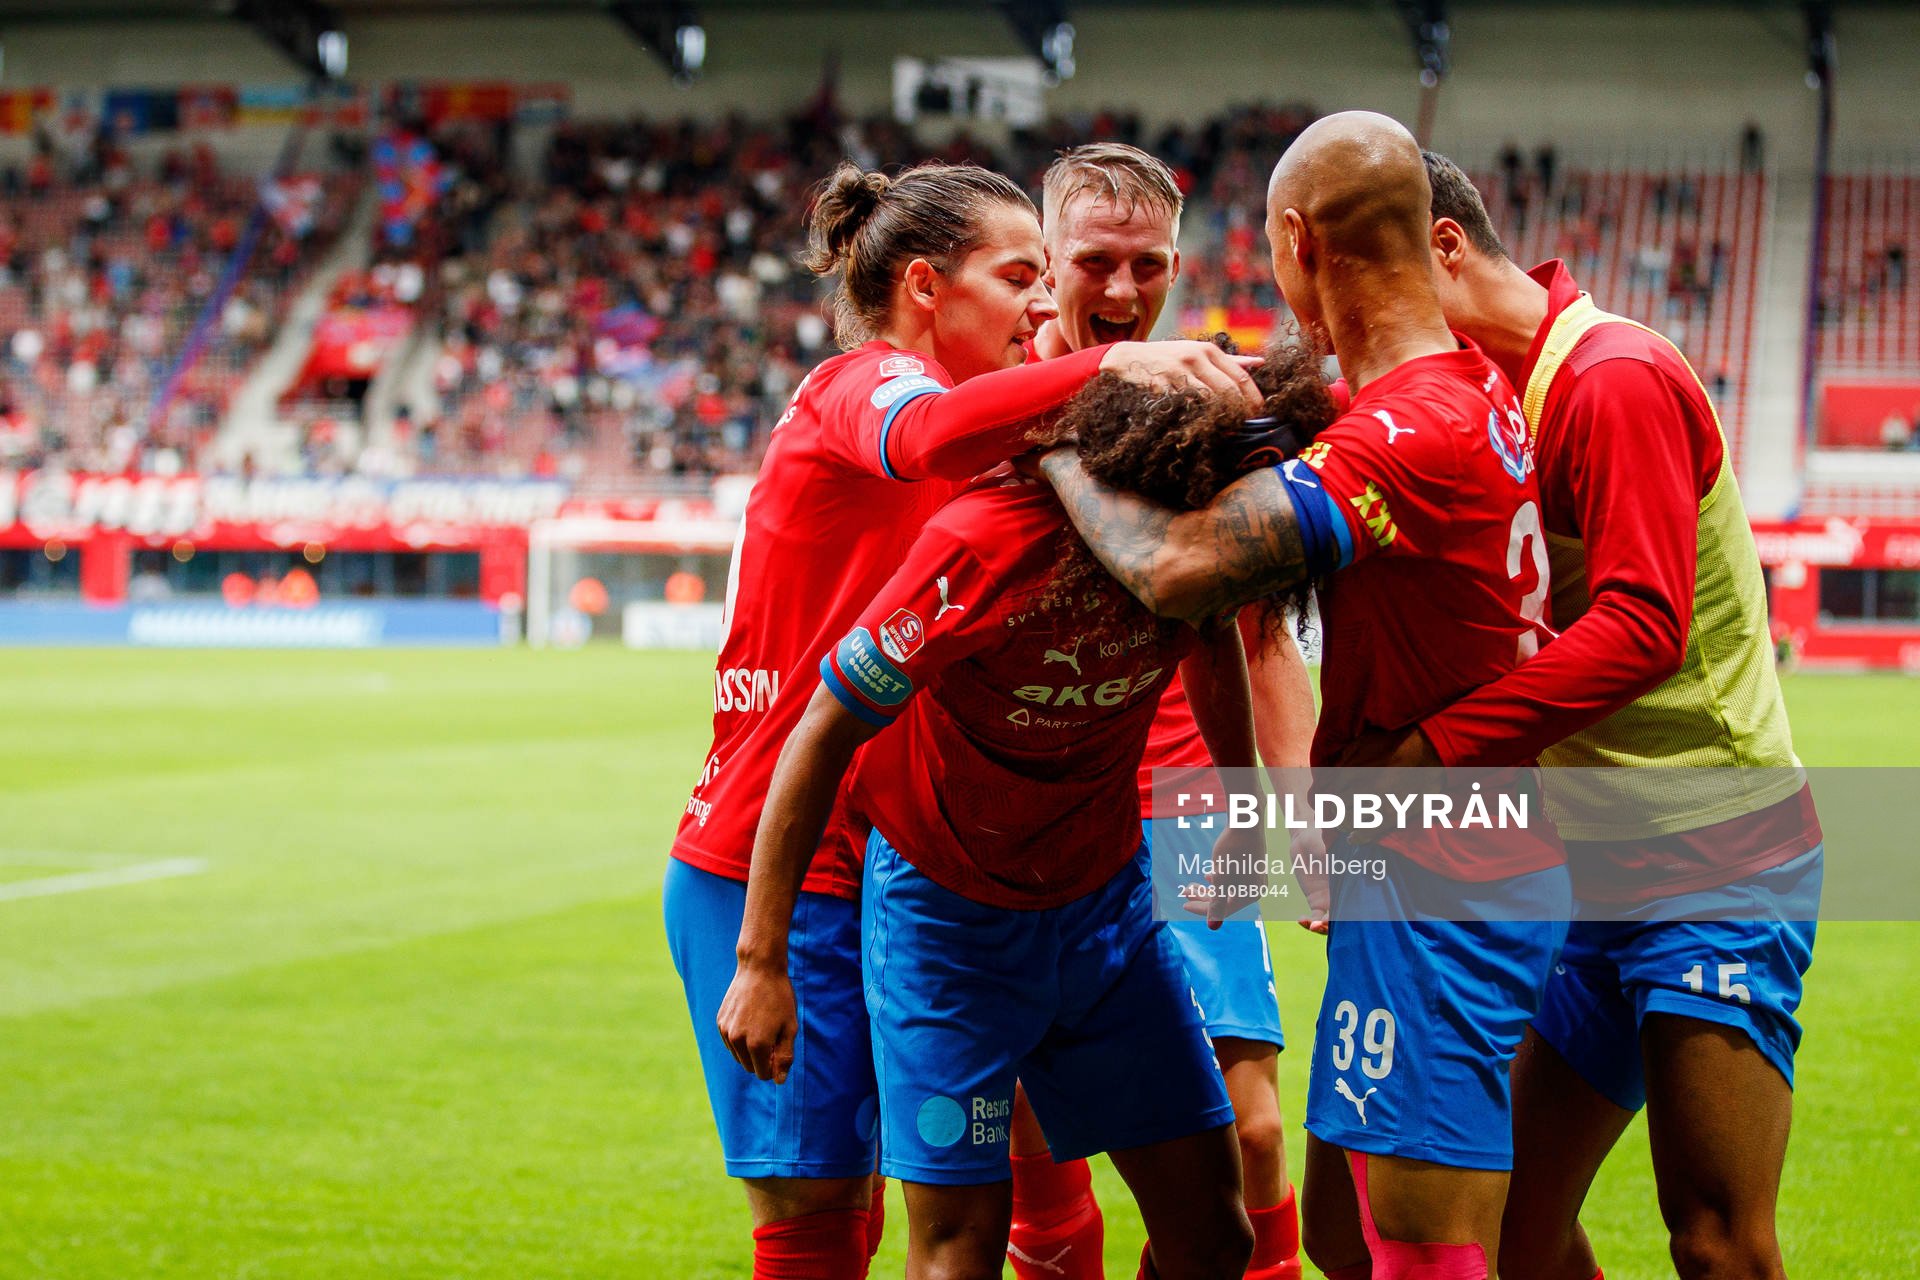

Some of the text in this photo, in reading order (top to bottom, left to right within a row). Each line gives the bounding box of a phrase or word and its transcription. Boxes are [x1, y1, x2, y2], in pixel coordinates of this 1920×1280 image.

[850, 635, 905, 693] UNIBET
[1034, 716, 1070, 729] PART
[1682, 963, 1751, 1004] 15
[1332, 1000, 1396, 1080] 39
[972, 1122, 1009, 1145] Bank
